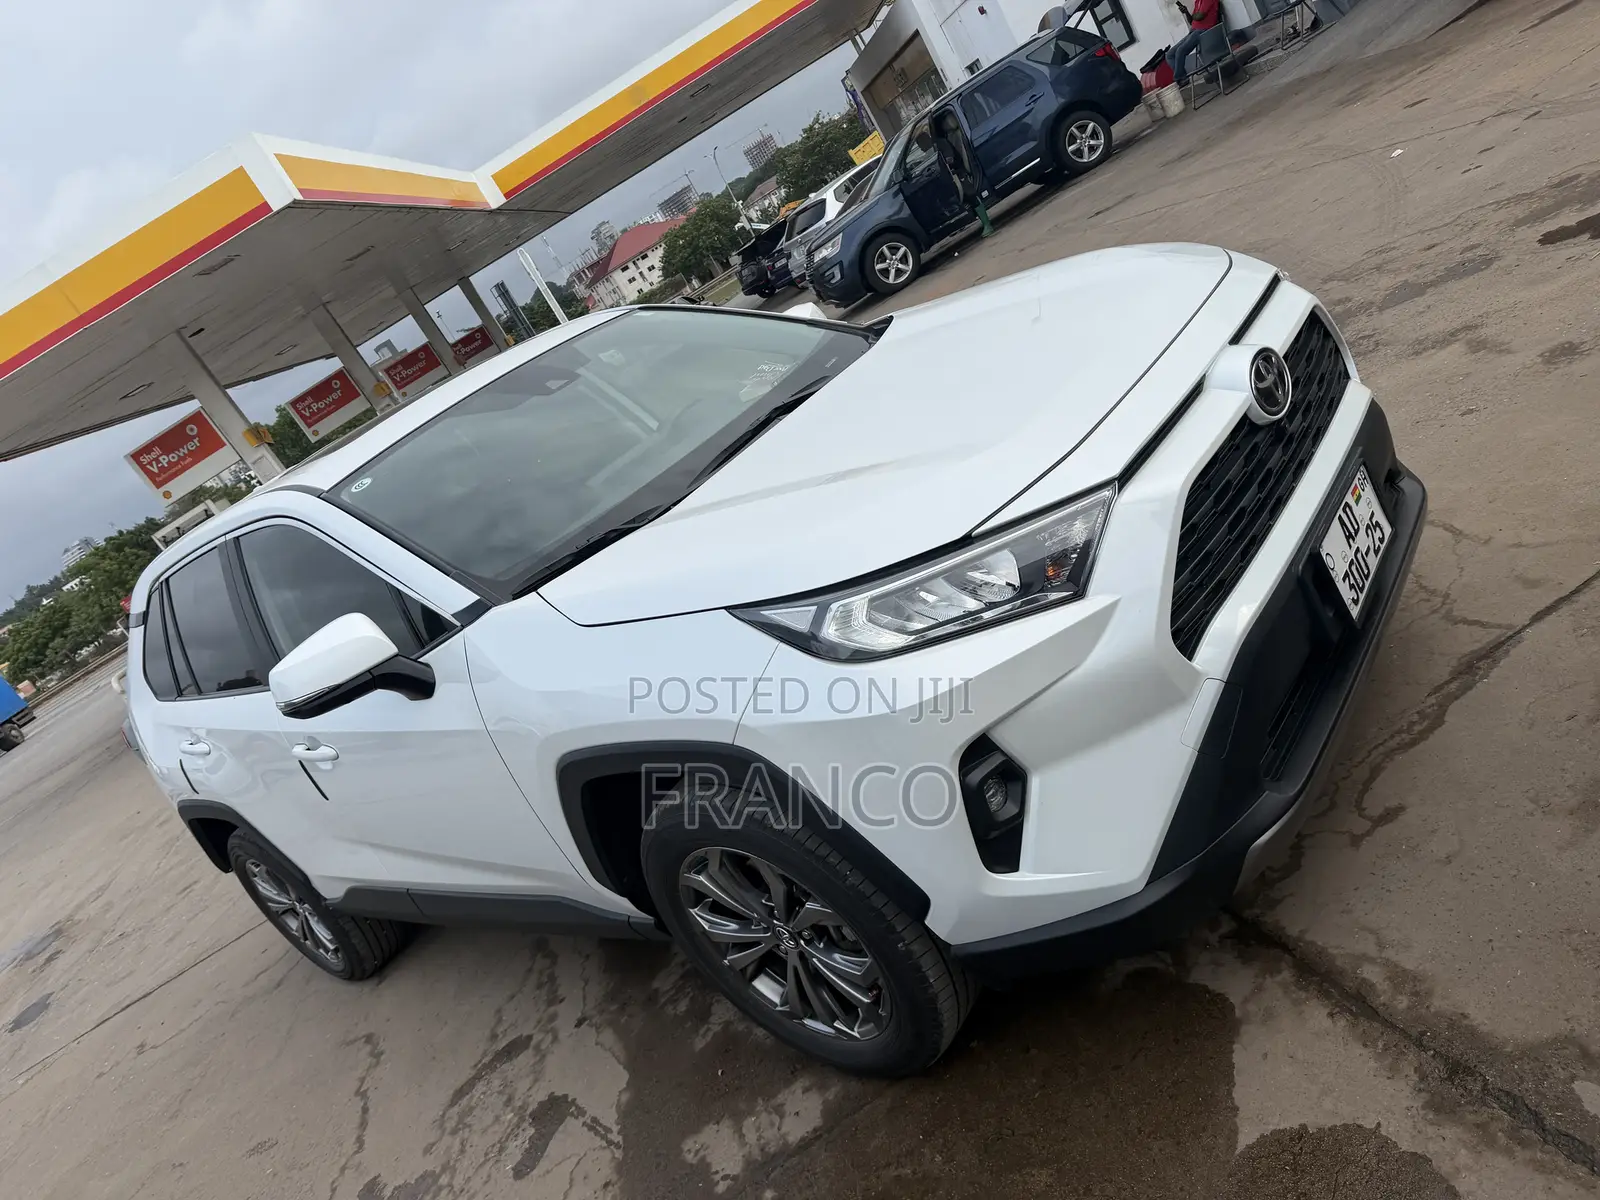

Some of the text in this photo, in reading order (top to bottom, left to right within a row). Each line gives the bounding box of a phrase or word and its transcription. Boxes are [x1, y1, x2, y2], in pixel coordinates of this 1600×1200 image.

[393, 360, 427, 381] V-Power
[296, 396, 315, 411] Shell
[301, 389, 342, 417] V-Power
[140, 446, 162, 465] Shell
[146, 437, 200, 473] V-Power
[1337, 501, 1360, 550] AD
[1342, 510, 1385, 607] 300-25
